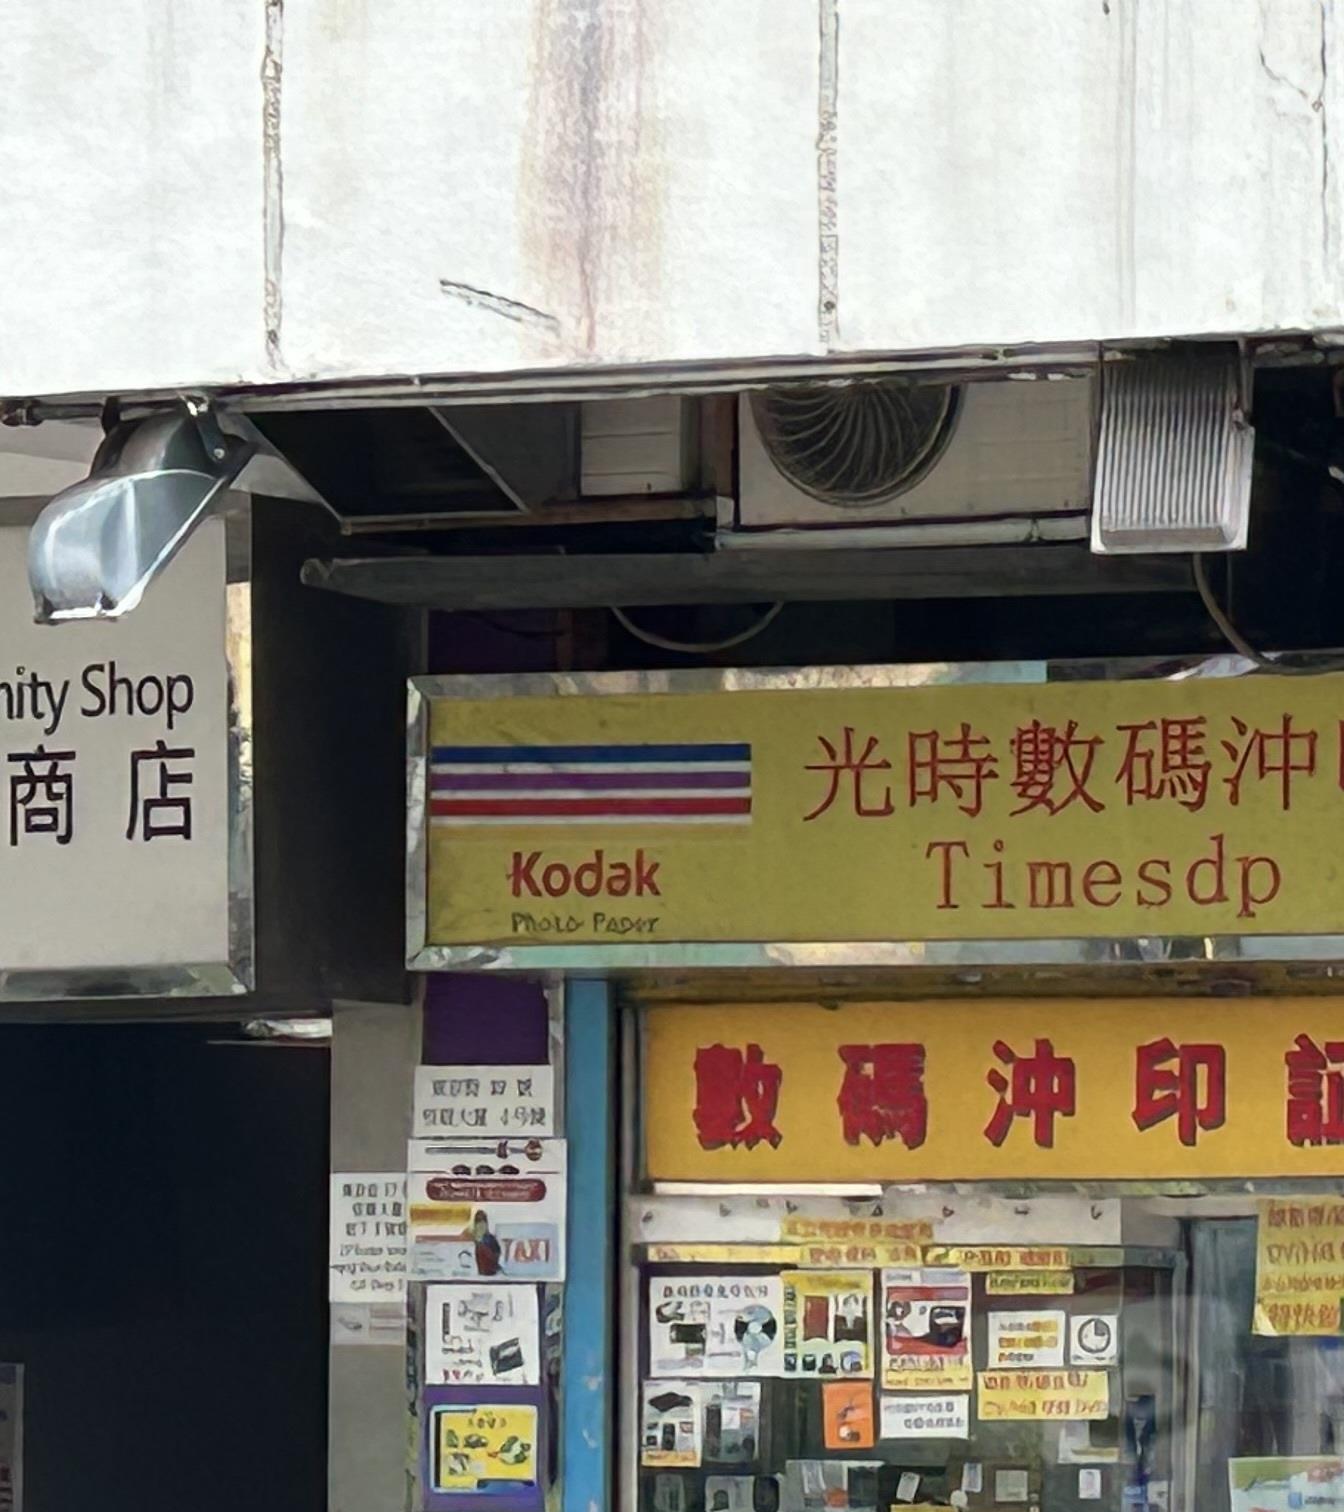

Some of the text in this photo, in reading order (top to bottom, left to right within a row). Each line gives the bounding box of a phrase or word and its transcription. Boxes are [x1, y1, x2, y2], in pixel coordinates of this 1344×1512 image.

[81, 660, 194, 730] Shop
[6, 739, 196, 847] 商店
[510, 848, 662, 898] Kodak
[925, 834, 1282, 918] Timesdp
